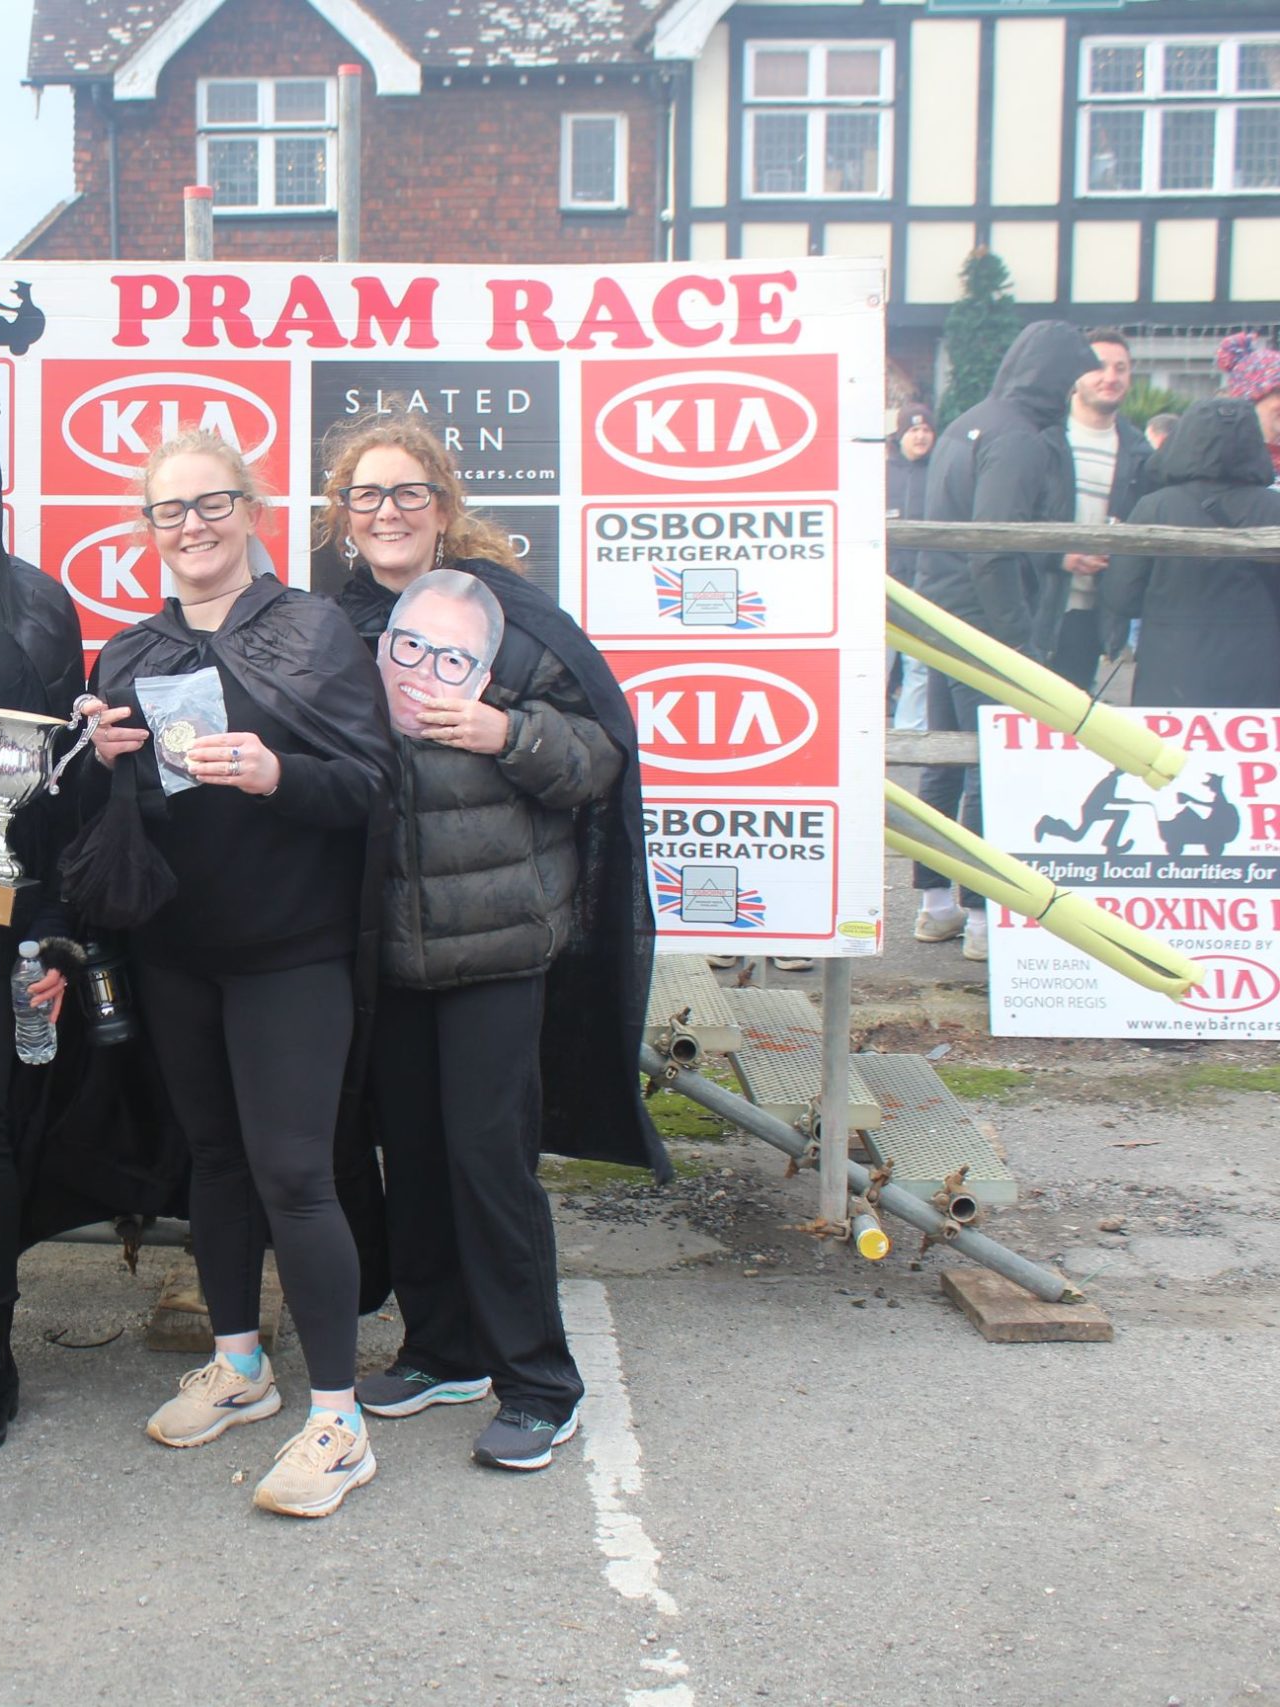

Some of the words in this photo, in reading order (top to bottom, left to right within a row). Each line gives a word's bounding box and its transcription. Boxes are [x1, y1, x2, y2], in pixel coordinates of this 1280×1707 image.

[110, 274, 440, 348] PRAM
[485, 270, 802, 351] RACE
[345, 389, 531, 414] SLATED
[633, 397, 782, 454] KIA
[444, 427, 503, 451] RN
[595, 511, 824, 541] OSBORNE
[596, 544, 825, 562] REFRIGERATORS
[634, 691, 783, 745] KIA
[1143, 713, 1280, 753] PAG
[642, 808, 824, 839] SBORNE
[647, 842, 825, 861] RIGERATORS
[1103, 861, 1151, 879] local
[1157, 862, 1243, 880] charities
[1243, 863, 1277, 884] for
[1255, 939, 1273, 950] BY
[1017, 959, 1049, 970] NEW
[1053, 959, 1091, 971] BARN
[1011, 977, 1098, 990] SHOWROOM
[1004, 996, 1066, 1008] BOGNOR
[1068, 997, 1108, 1009] REGIS
